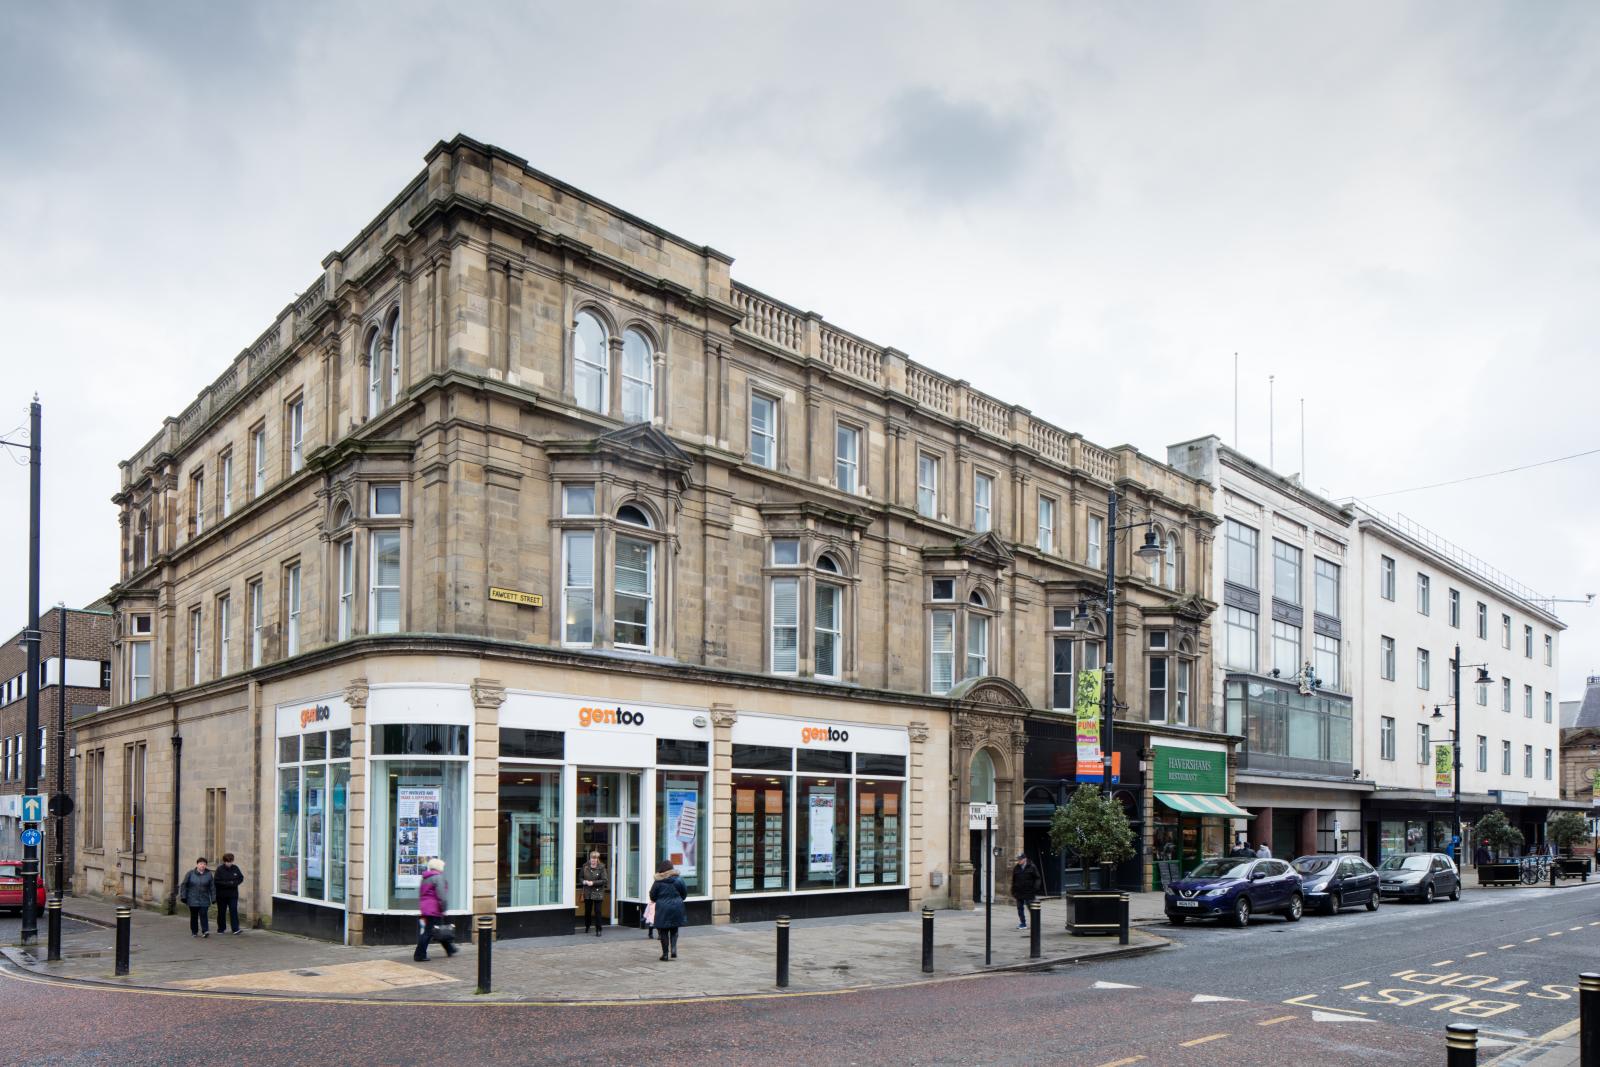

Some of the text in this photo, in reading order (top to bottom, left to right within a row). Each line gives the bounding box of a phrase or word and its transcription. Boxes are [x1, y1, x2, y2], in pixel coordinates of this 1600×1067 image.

[492, 590, 541, 603] FAWCETT STREET
[301, 704, 330, 728] gentoo
[578, 707, 644, 727] gentoo
[801, 726, 849, 744] gentoo
[1390, 970, 1579, 1000] STOP
[1358, 988, 1521, 1018] BUS
